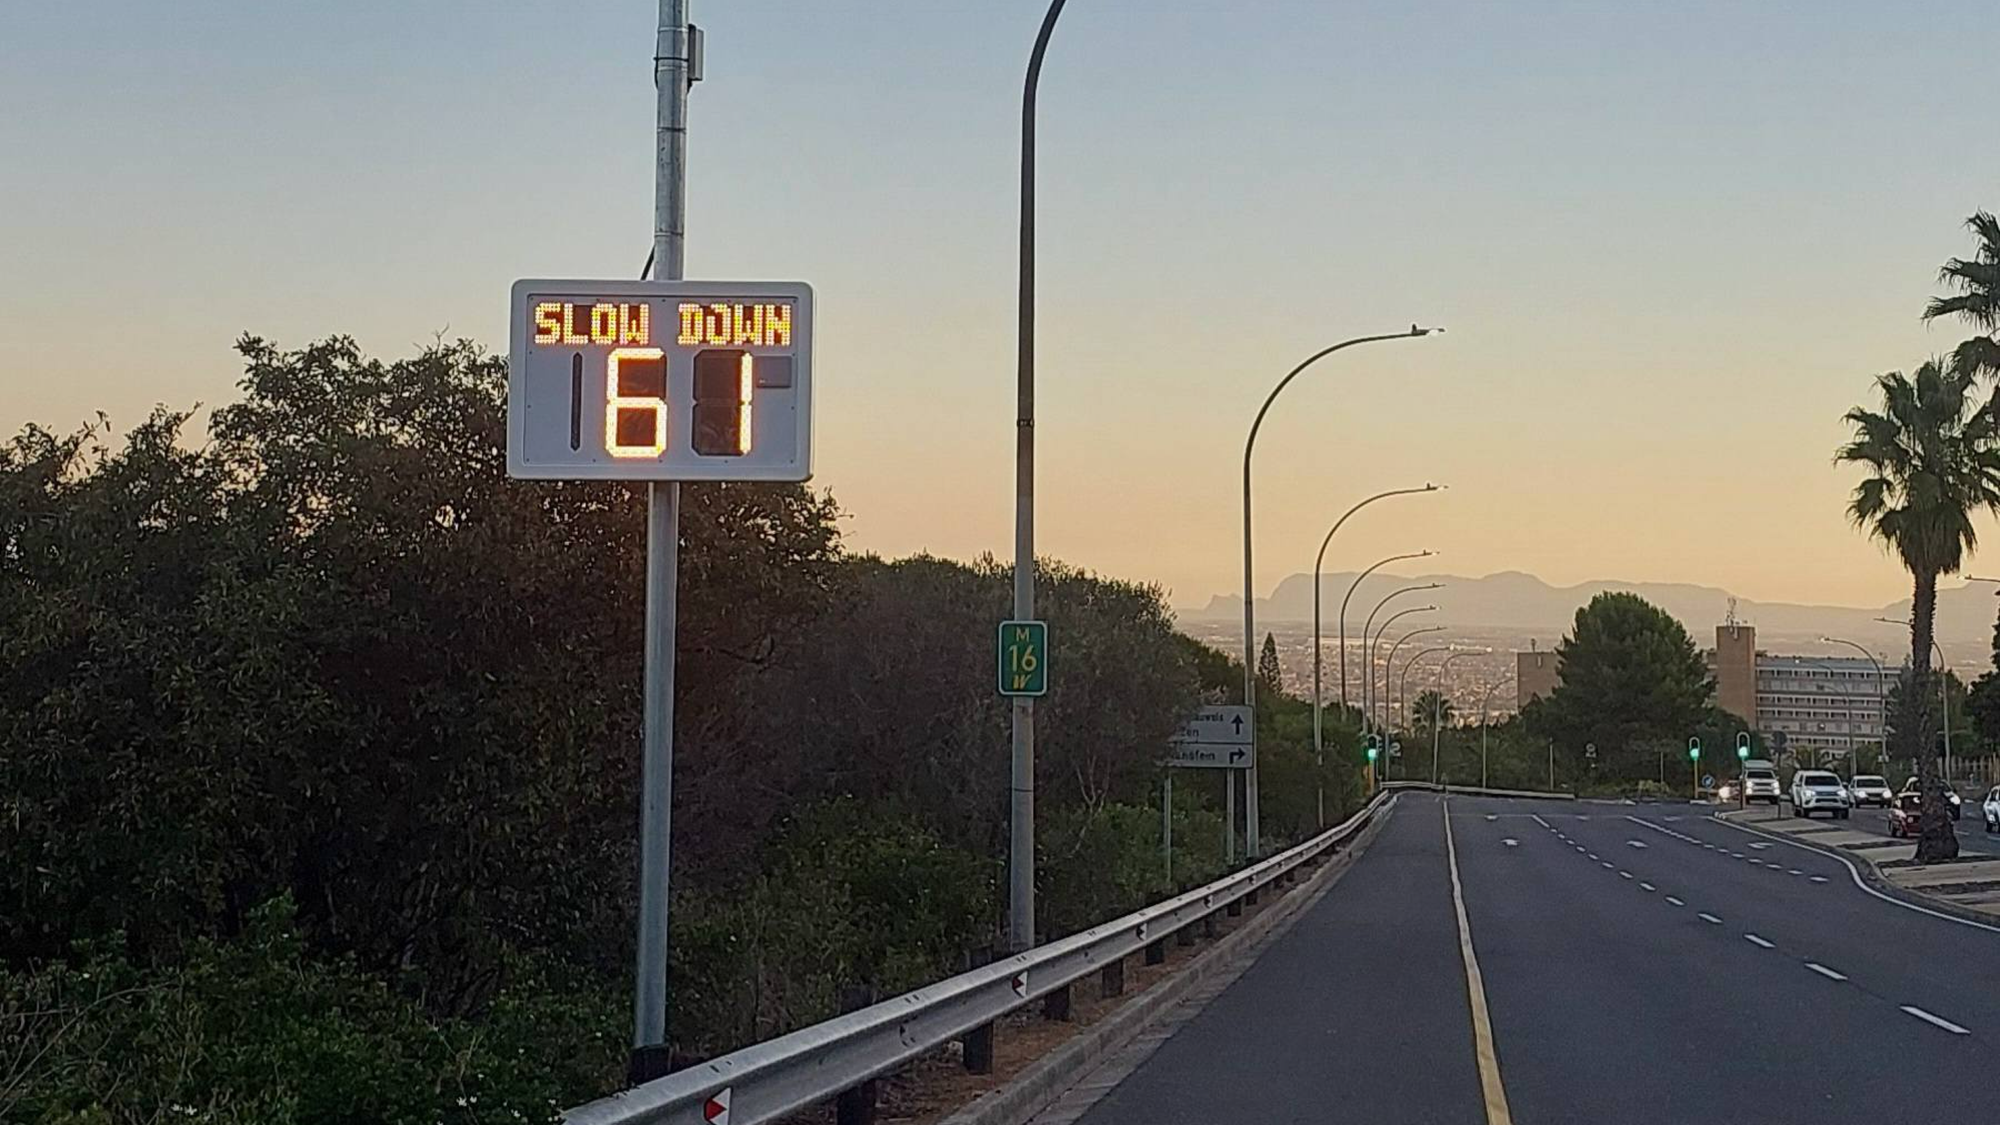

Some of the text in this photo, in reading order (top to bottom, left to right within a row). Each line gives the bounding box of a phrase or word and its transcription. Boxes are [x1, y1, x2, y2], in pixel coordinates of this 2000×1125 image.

[534, 302, 792, 346] SLOW DOWN
[605, 347, 754, 458] 61
[1016, 626, 1030, 642] M
[1009, 644, 1037, 672] 16
